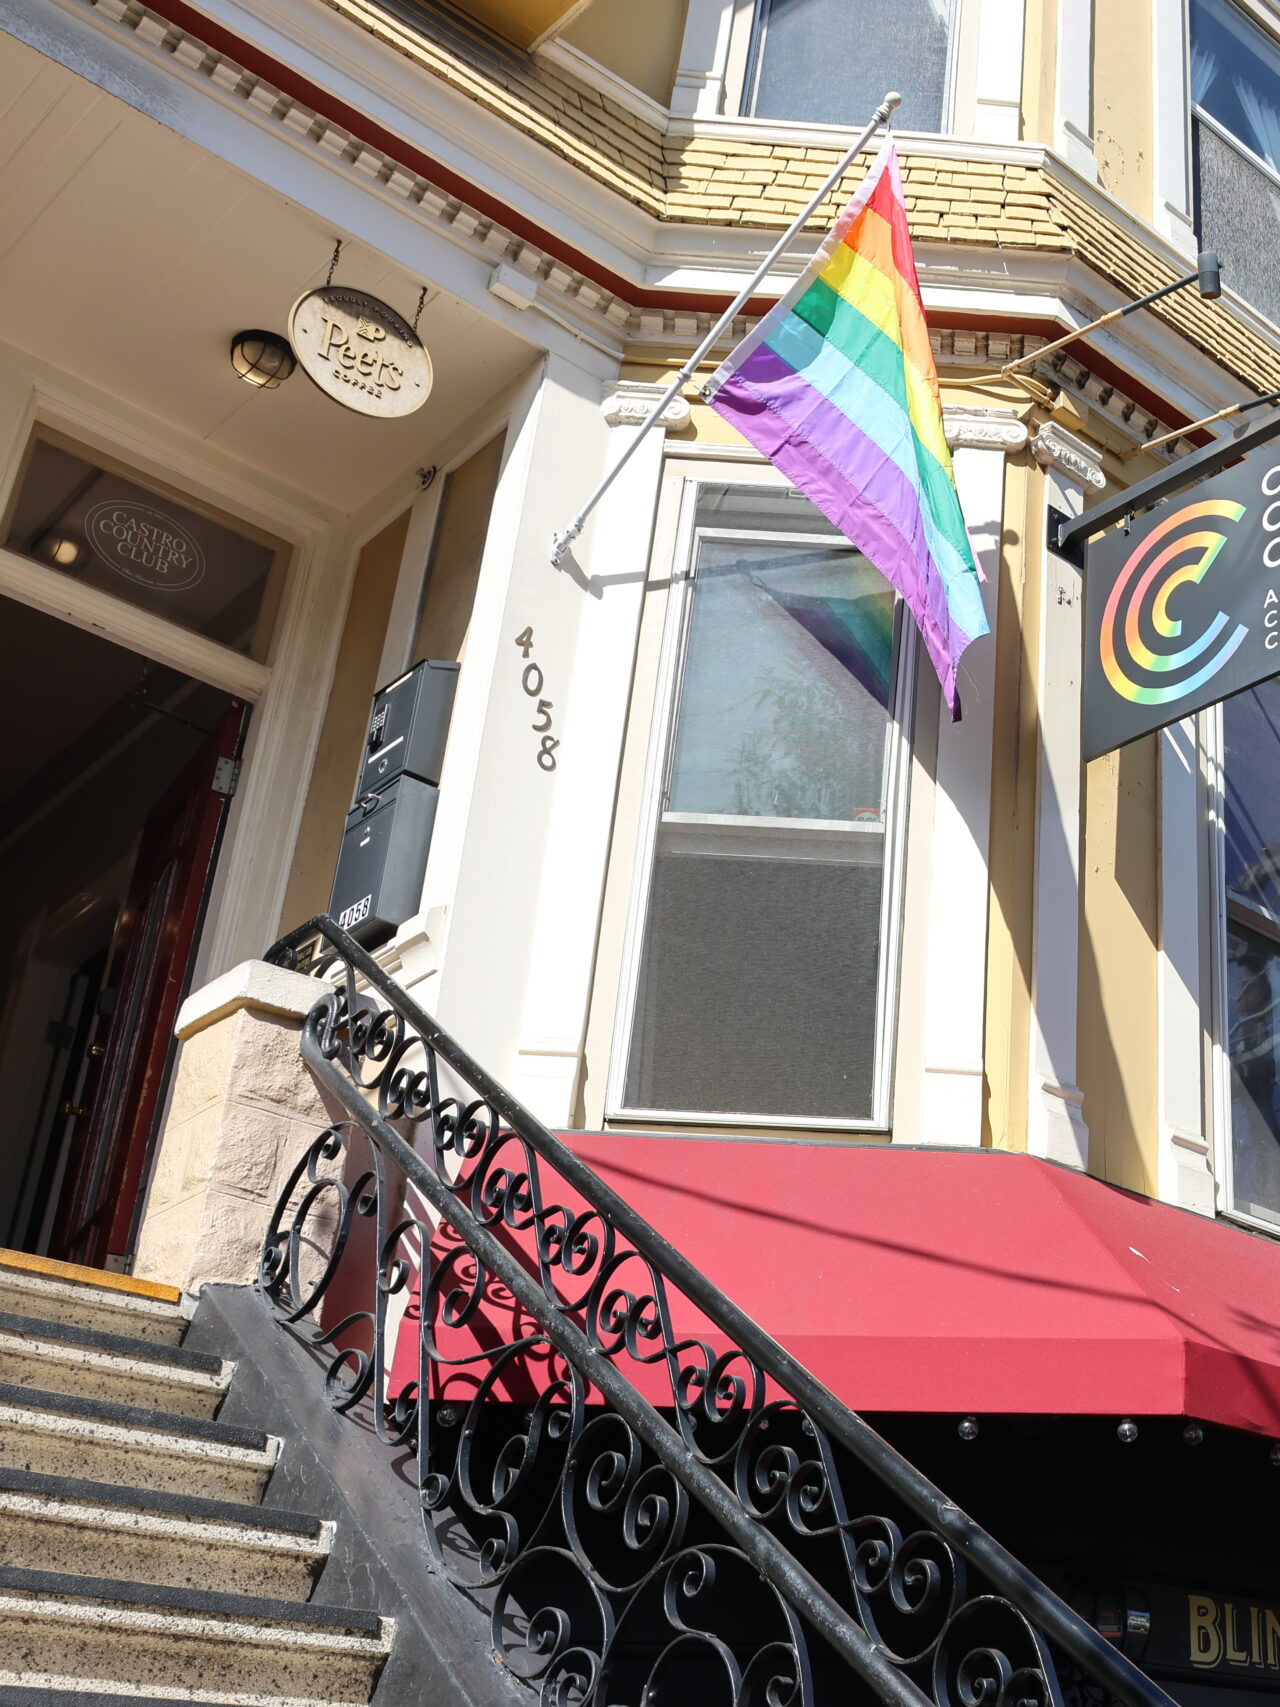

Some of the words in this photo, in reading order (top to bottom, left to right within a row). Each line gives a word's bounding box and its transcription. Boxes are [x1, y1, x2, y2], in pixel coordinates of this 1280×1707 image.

[332, 369, 383, 399] COFFEE
[99, 519, 193, 569] COUNTRY
[113, 511, 187, 553] CASTRO
[117, 541, 169, 573] CLUB
[1263, 589, 1279, 609] A
[514, 626, 561, 772] 4058
[339, 898, 369, 927] 4058
